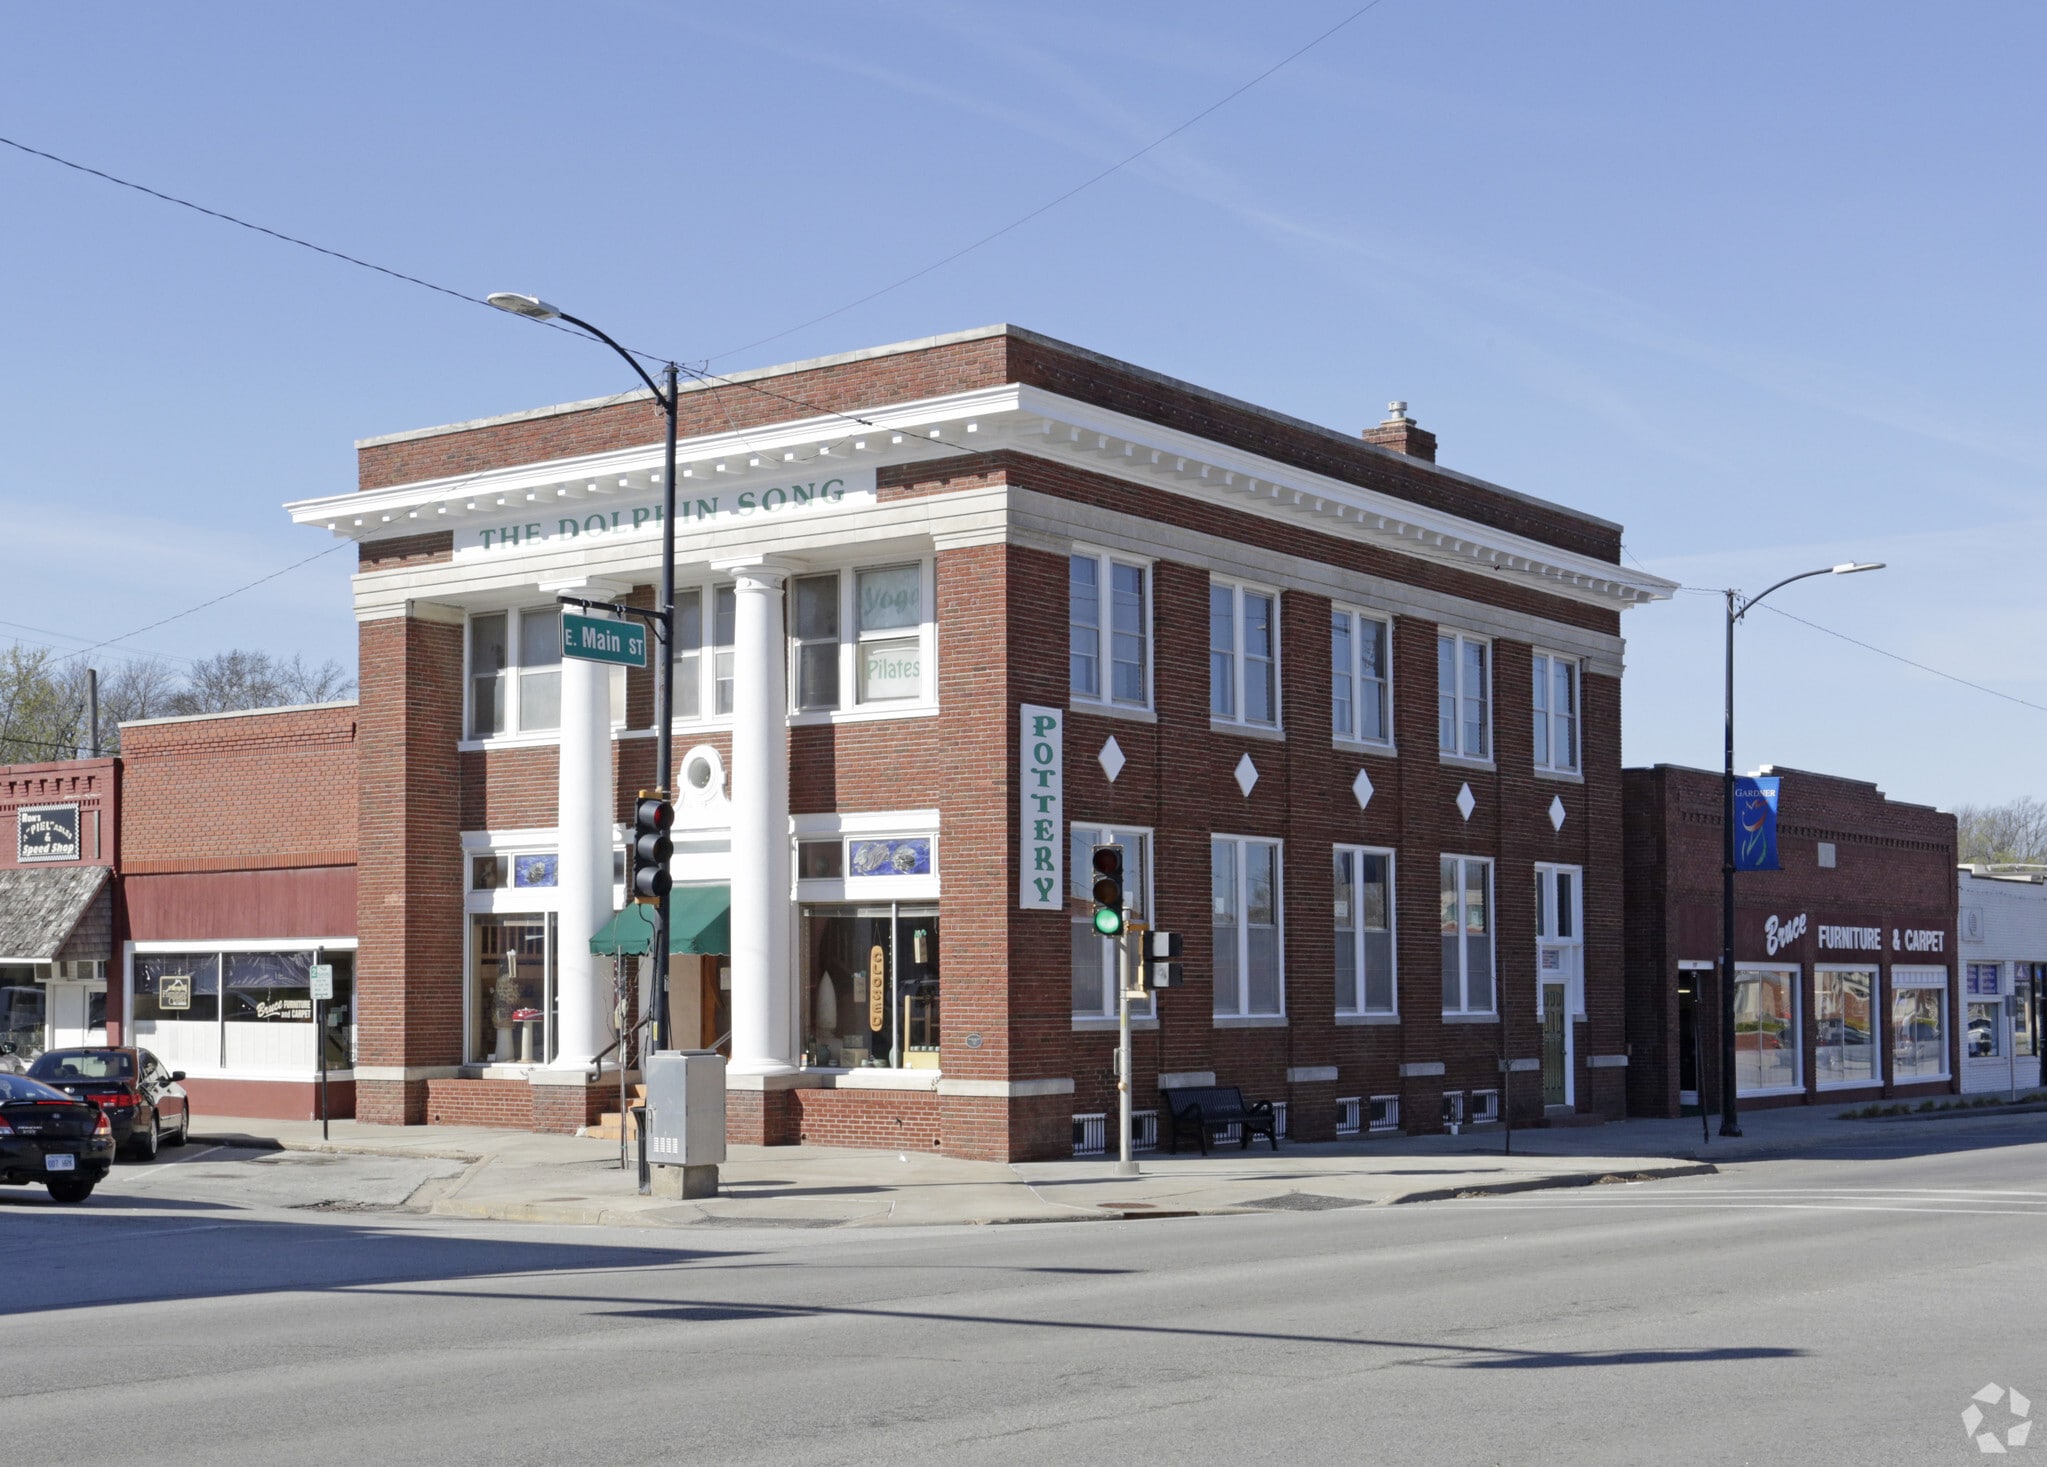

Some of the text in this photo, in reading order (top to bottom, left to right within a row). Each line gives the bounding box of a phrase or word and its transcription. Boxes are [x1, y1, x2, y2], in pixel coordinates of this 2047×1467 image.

[480, 523, 541, 551] THE
[738, 479, 845, 517] SONG
[565, 626, 643, 656] E. Main ST
[867, 659, 920, 680] Pilates
[1030, 716, 1057, 902] POTTERY
[22, 842, 75, 856] Speed Shop
[1764, 913, 1945, 956] Bruce FURNITURE & CARPET
[872, 953, 882, 1027] CLOSED
